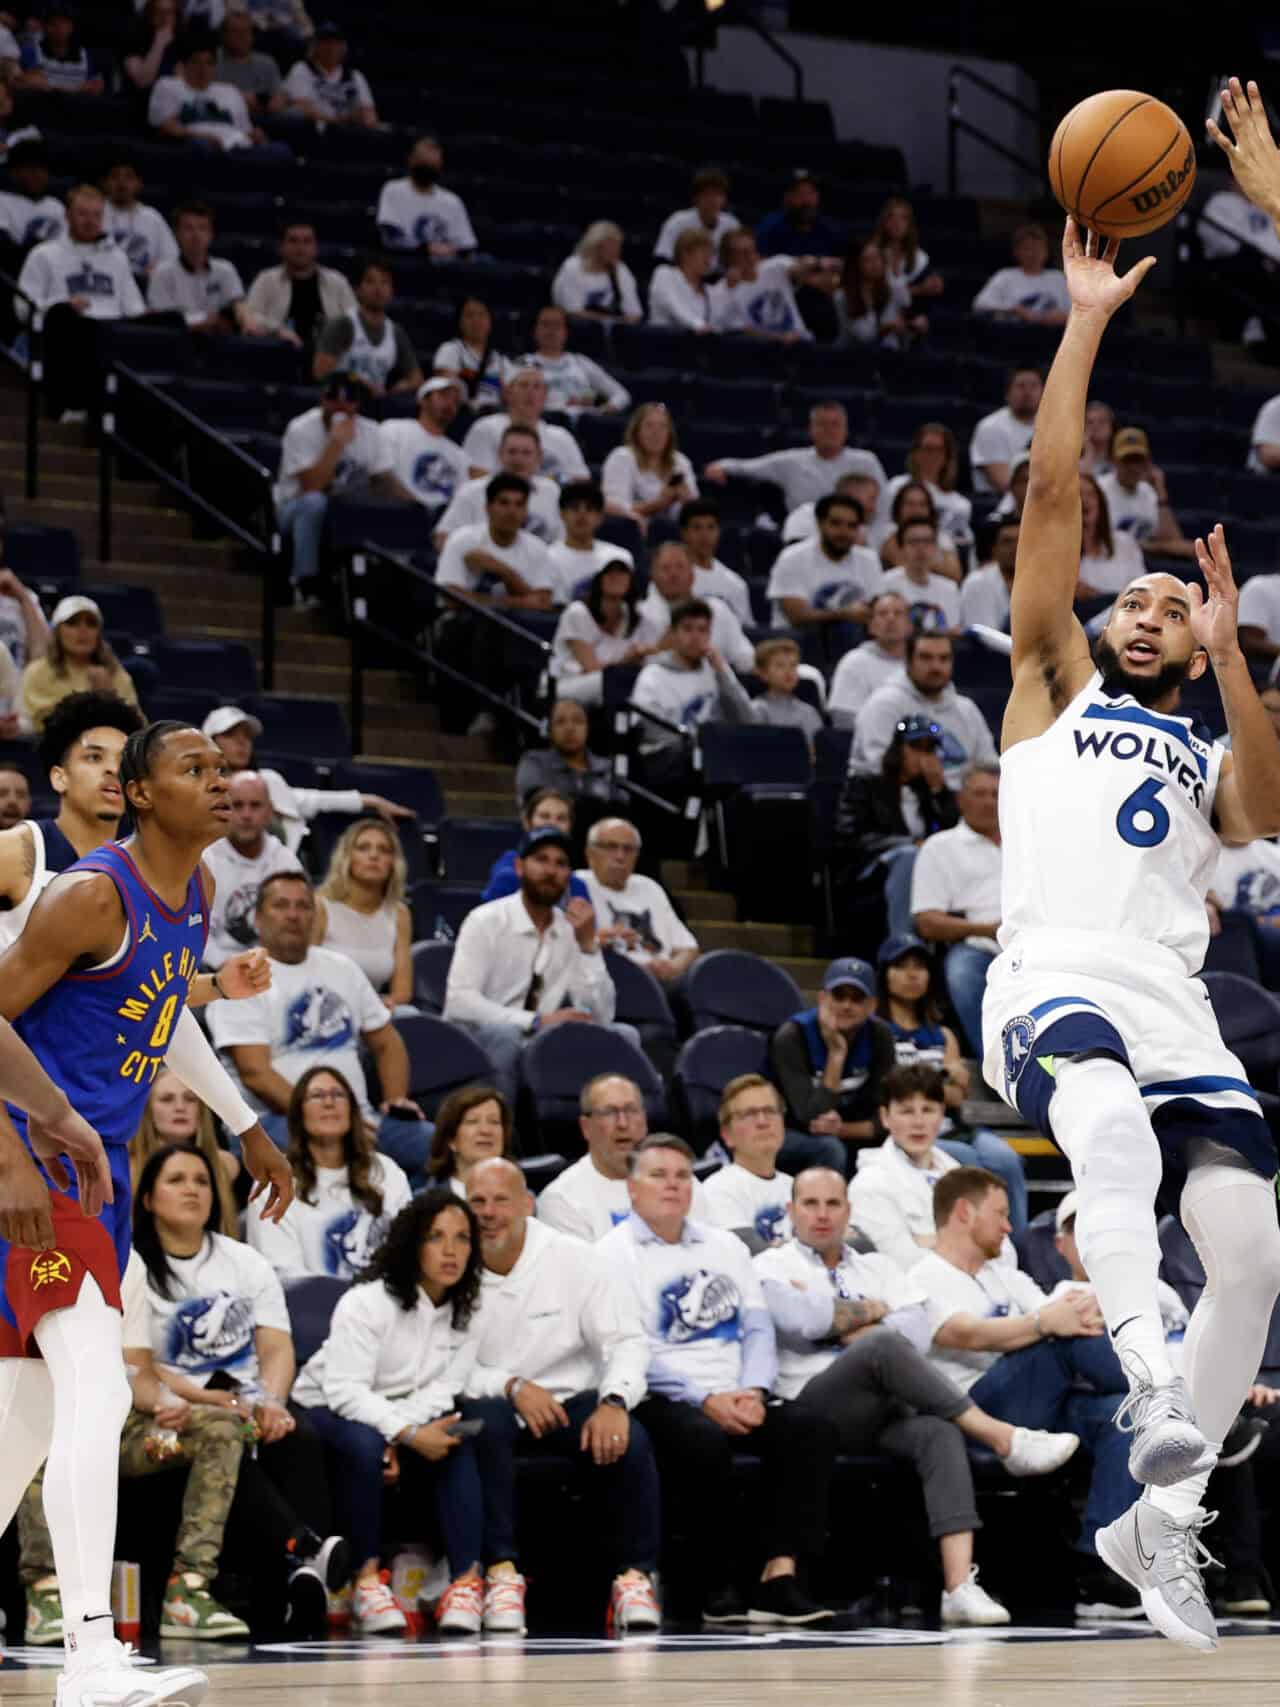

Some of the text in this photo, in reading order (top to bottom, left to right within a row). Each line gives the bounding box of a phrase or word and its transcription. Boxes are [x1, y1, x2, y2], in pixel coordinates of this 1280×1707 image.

[1073, 729, 1206, 809] WOLVES
[1115, 776, 1170, 849] 6
[117, 951, 176, 1023] MILE
[149, 993, 178, 1048] 8
